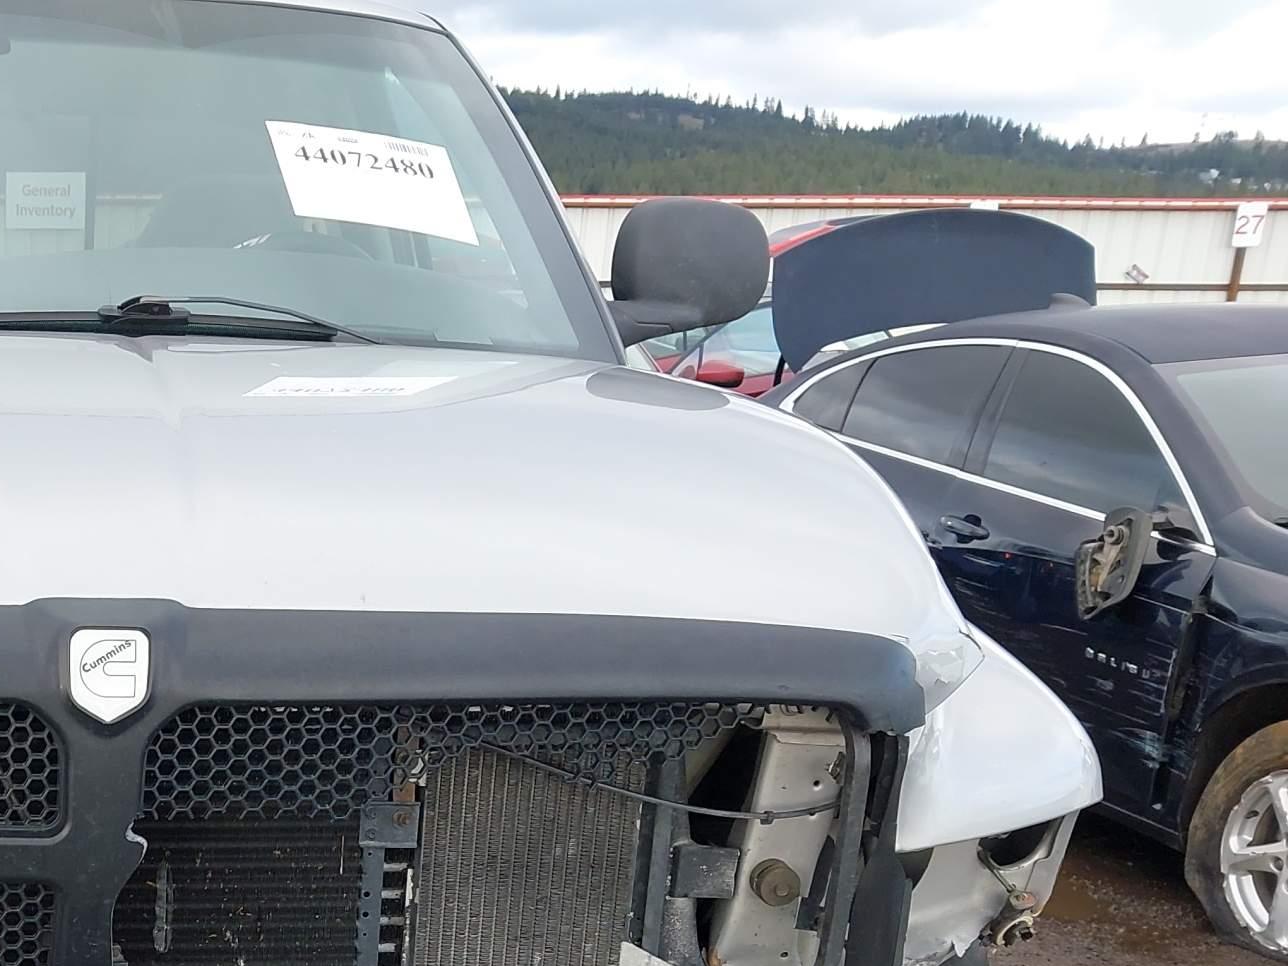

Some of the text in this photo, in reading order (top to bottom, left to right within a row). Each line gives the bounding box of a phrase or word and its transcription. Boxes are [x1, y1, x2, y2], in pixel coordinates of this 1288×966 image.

[294, 145, 435, 179] 44072480
[21, 184, 71, 197] General
[15, 204, 76, 219] Inventory
[1234, 214, 1265, 235] 27
[82, 639, 132, 673] Cummins
